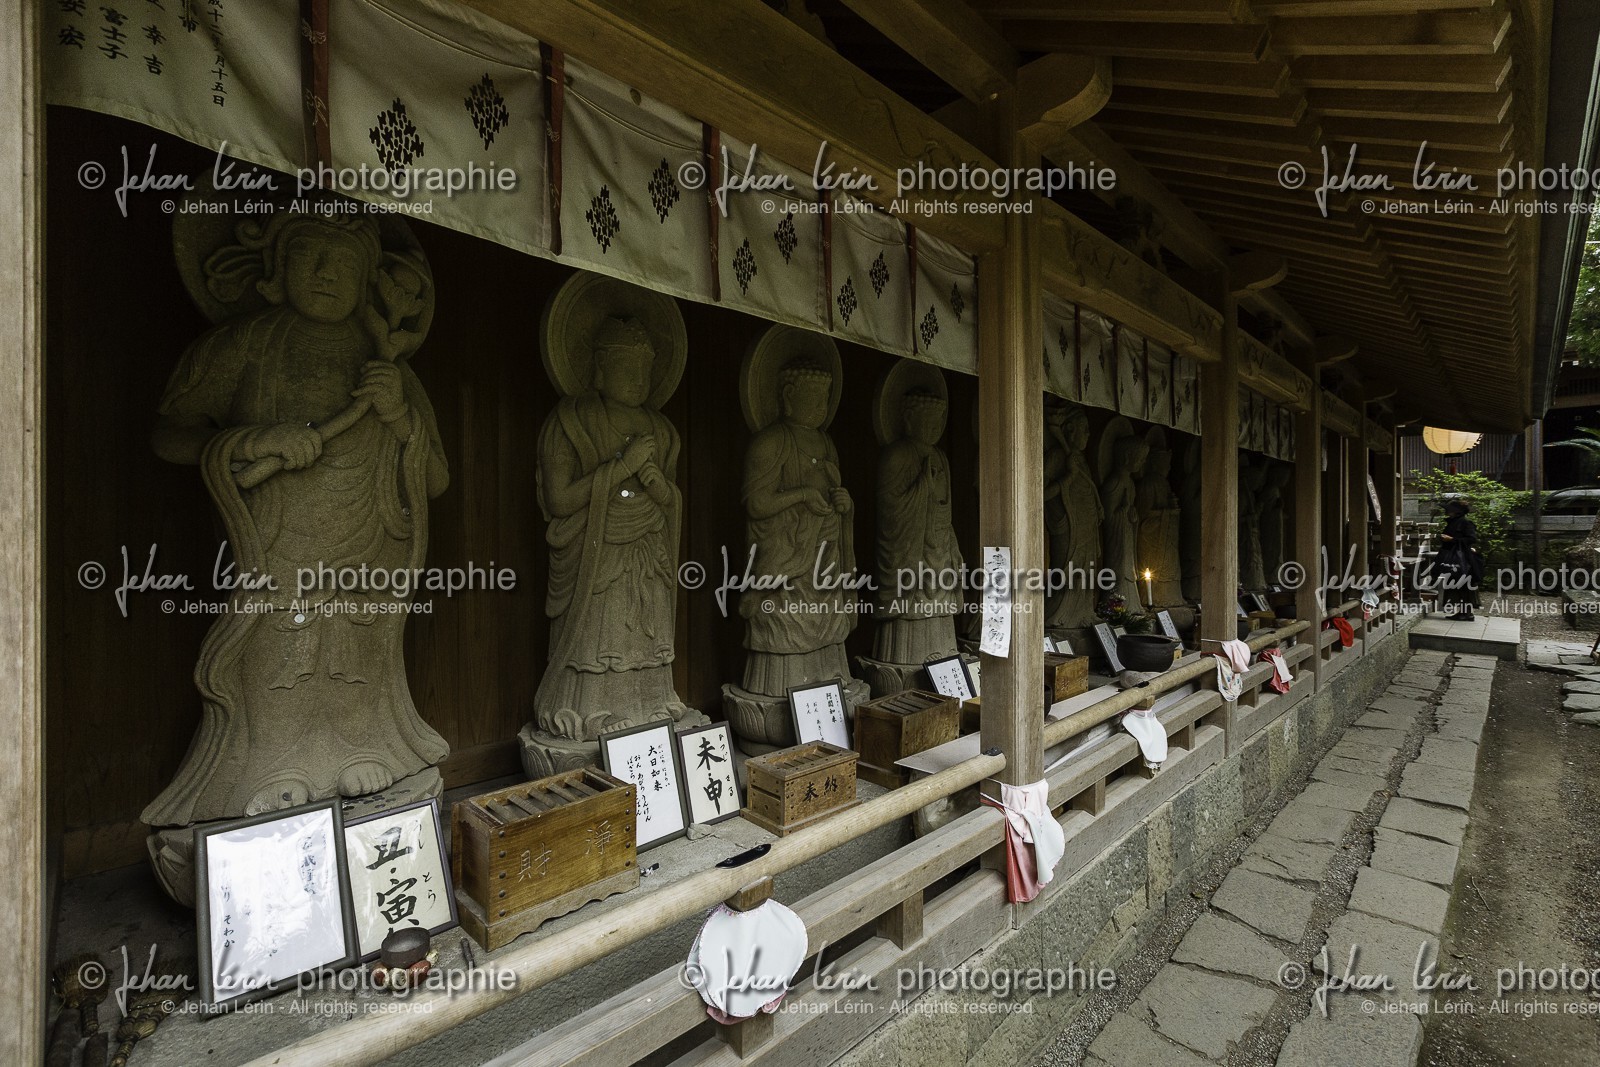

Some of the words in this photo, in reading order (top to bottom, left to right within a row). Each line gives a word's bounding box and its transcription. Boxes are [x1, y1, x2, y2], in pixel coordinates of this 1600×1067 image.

[648, 745, 663, 792] 大日如来
[803, 774, 838, 803] 奉納
